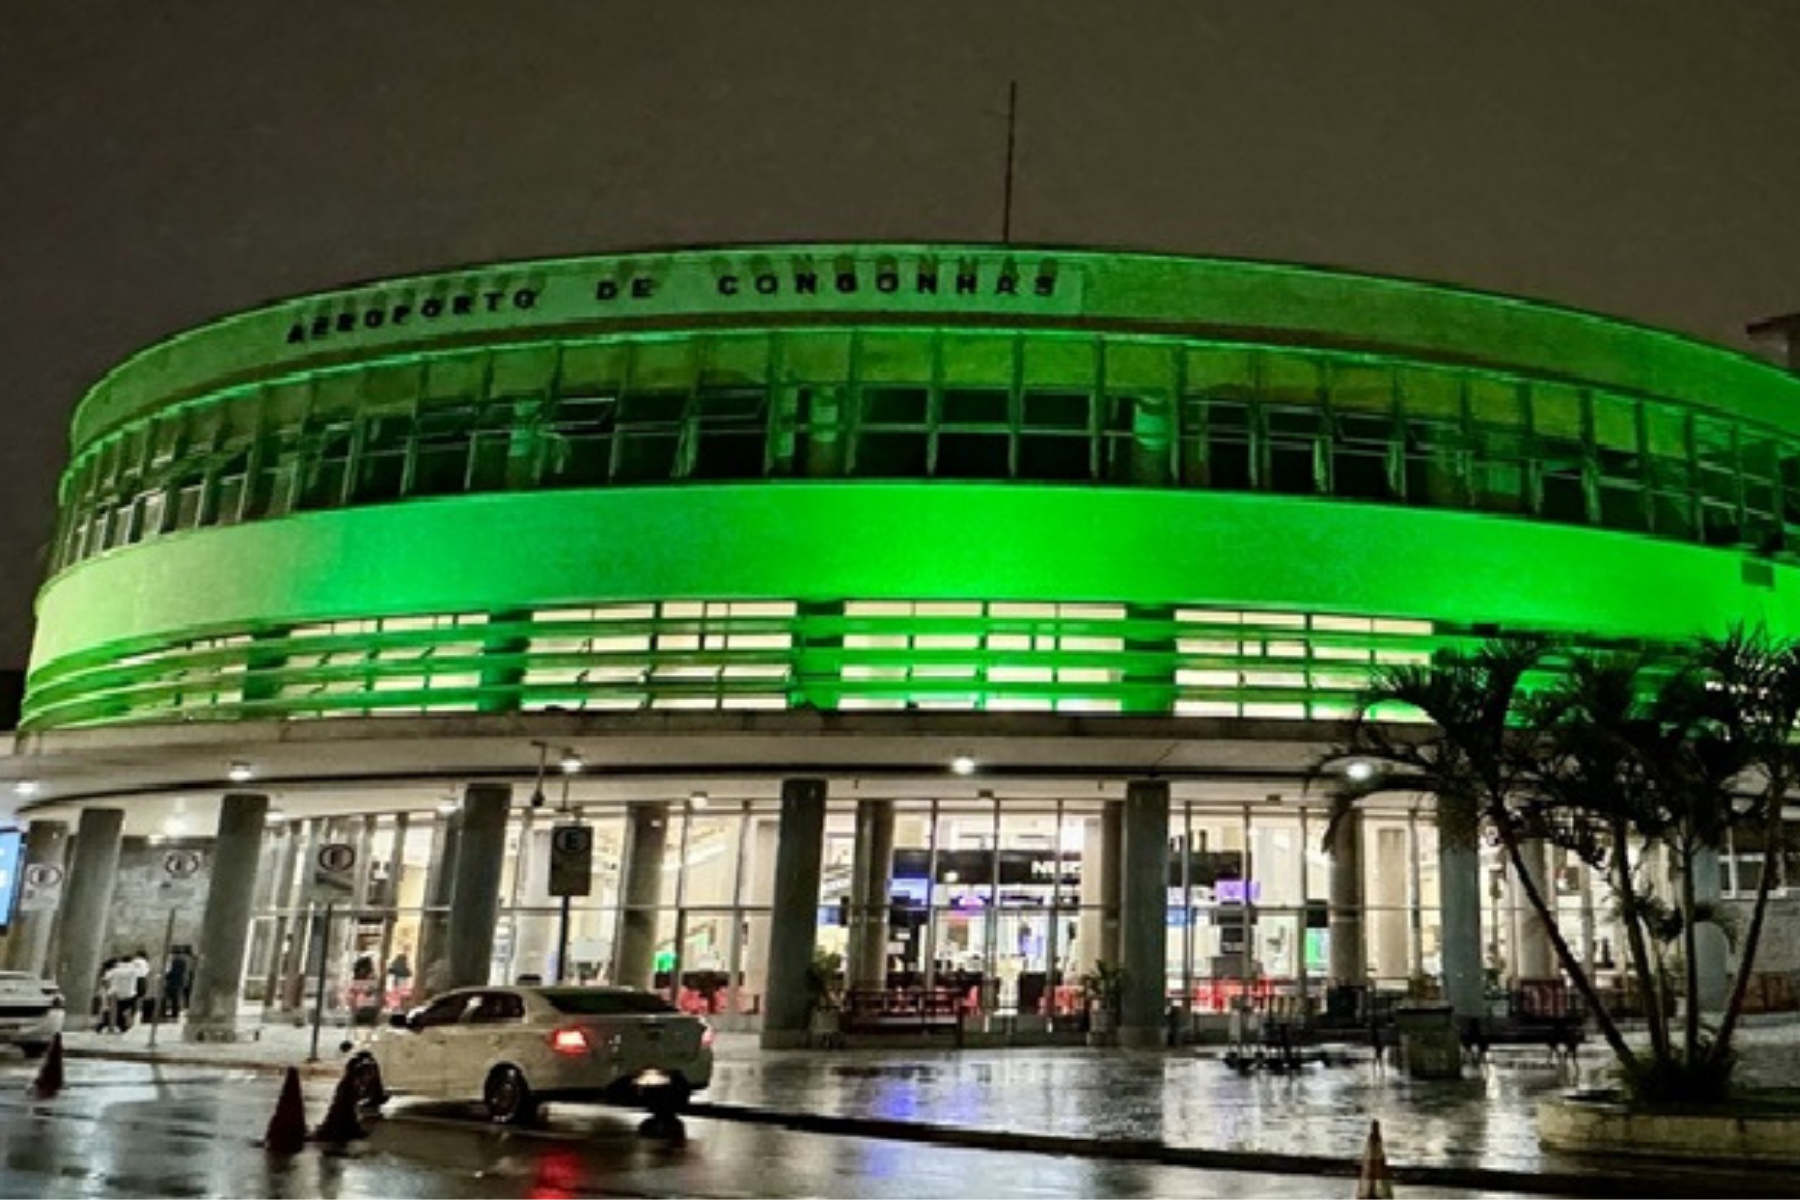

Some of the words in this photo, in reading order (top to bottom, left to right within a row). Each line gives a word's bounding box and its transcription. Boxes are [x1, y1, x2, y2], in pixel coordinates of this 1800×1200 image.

[287, 289, 536, 344] AEROPORTO
[596, 277, 655, 301] DE
[717, 272, 1056, 298] CONGONHAS
